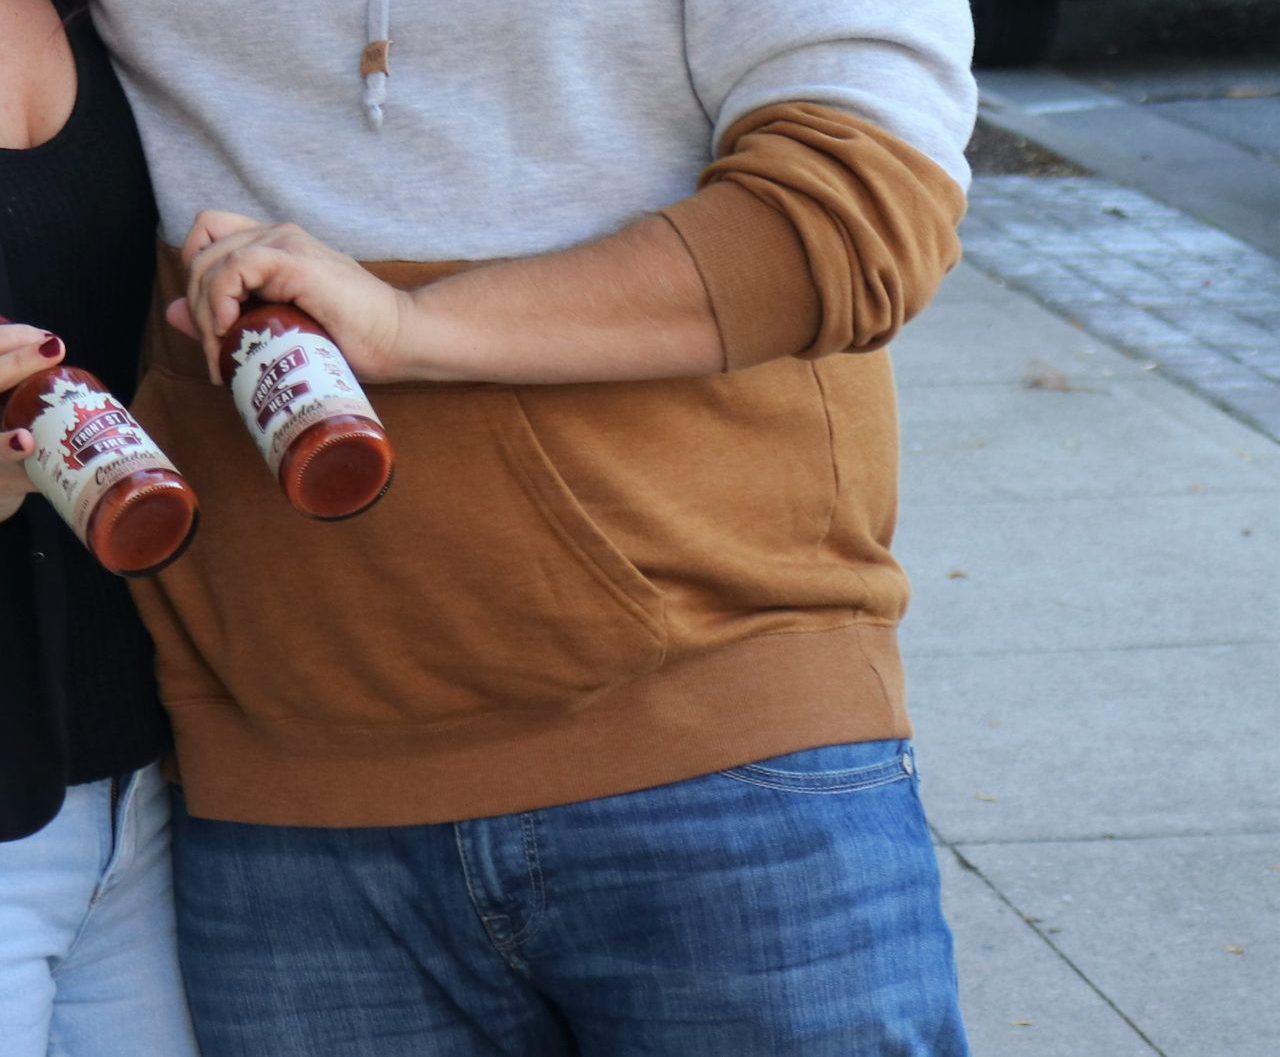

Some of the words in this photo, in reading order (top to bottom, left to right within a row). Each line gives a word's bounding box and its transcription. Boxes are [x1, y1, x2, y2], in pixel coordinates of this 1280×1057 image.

[254, 369, 278, 408] FRONT
[279, 353, 297, 373] ST
[268, 389, 295, 413] HEAT
[75, 419, 105, 446] FRONT
[104, 413, 122, 425] ST
[94, 437, 127, 453] FIRE
